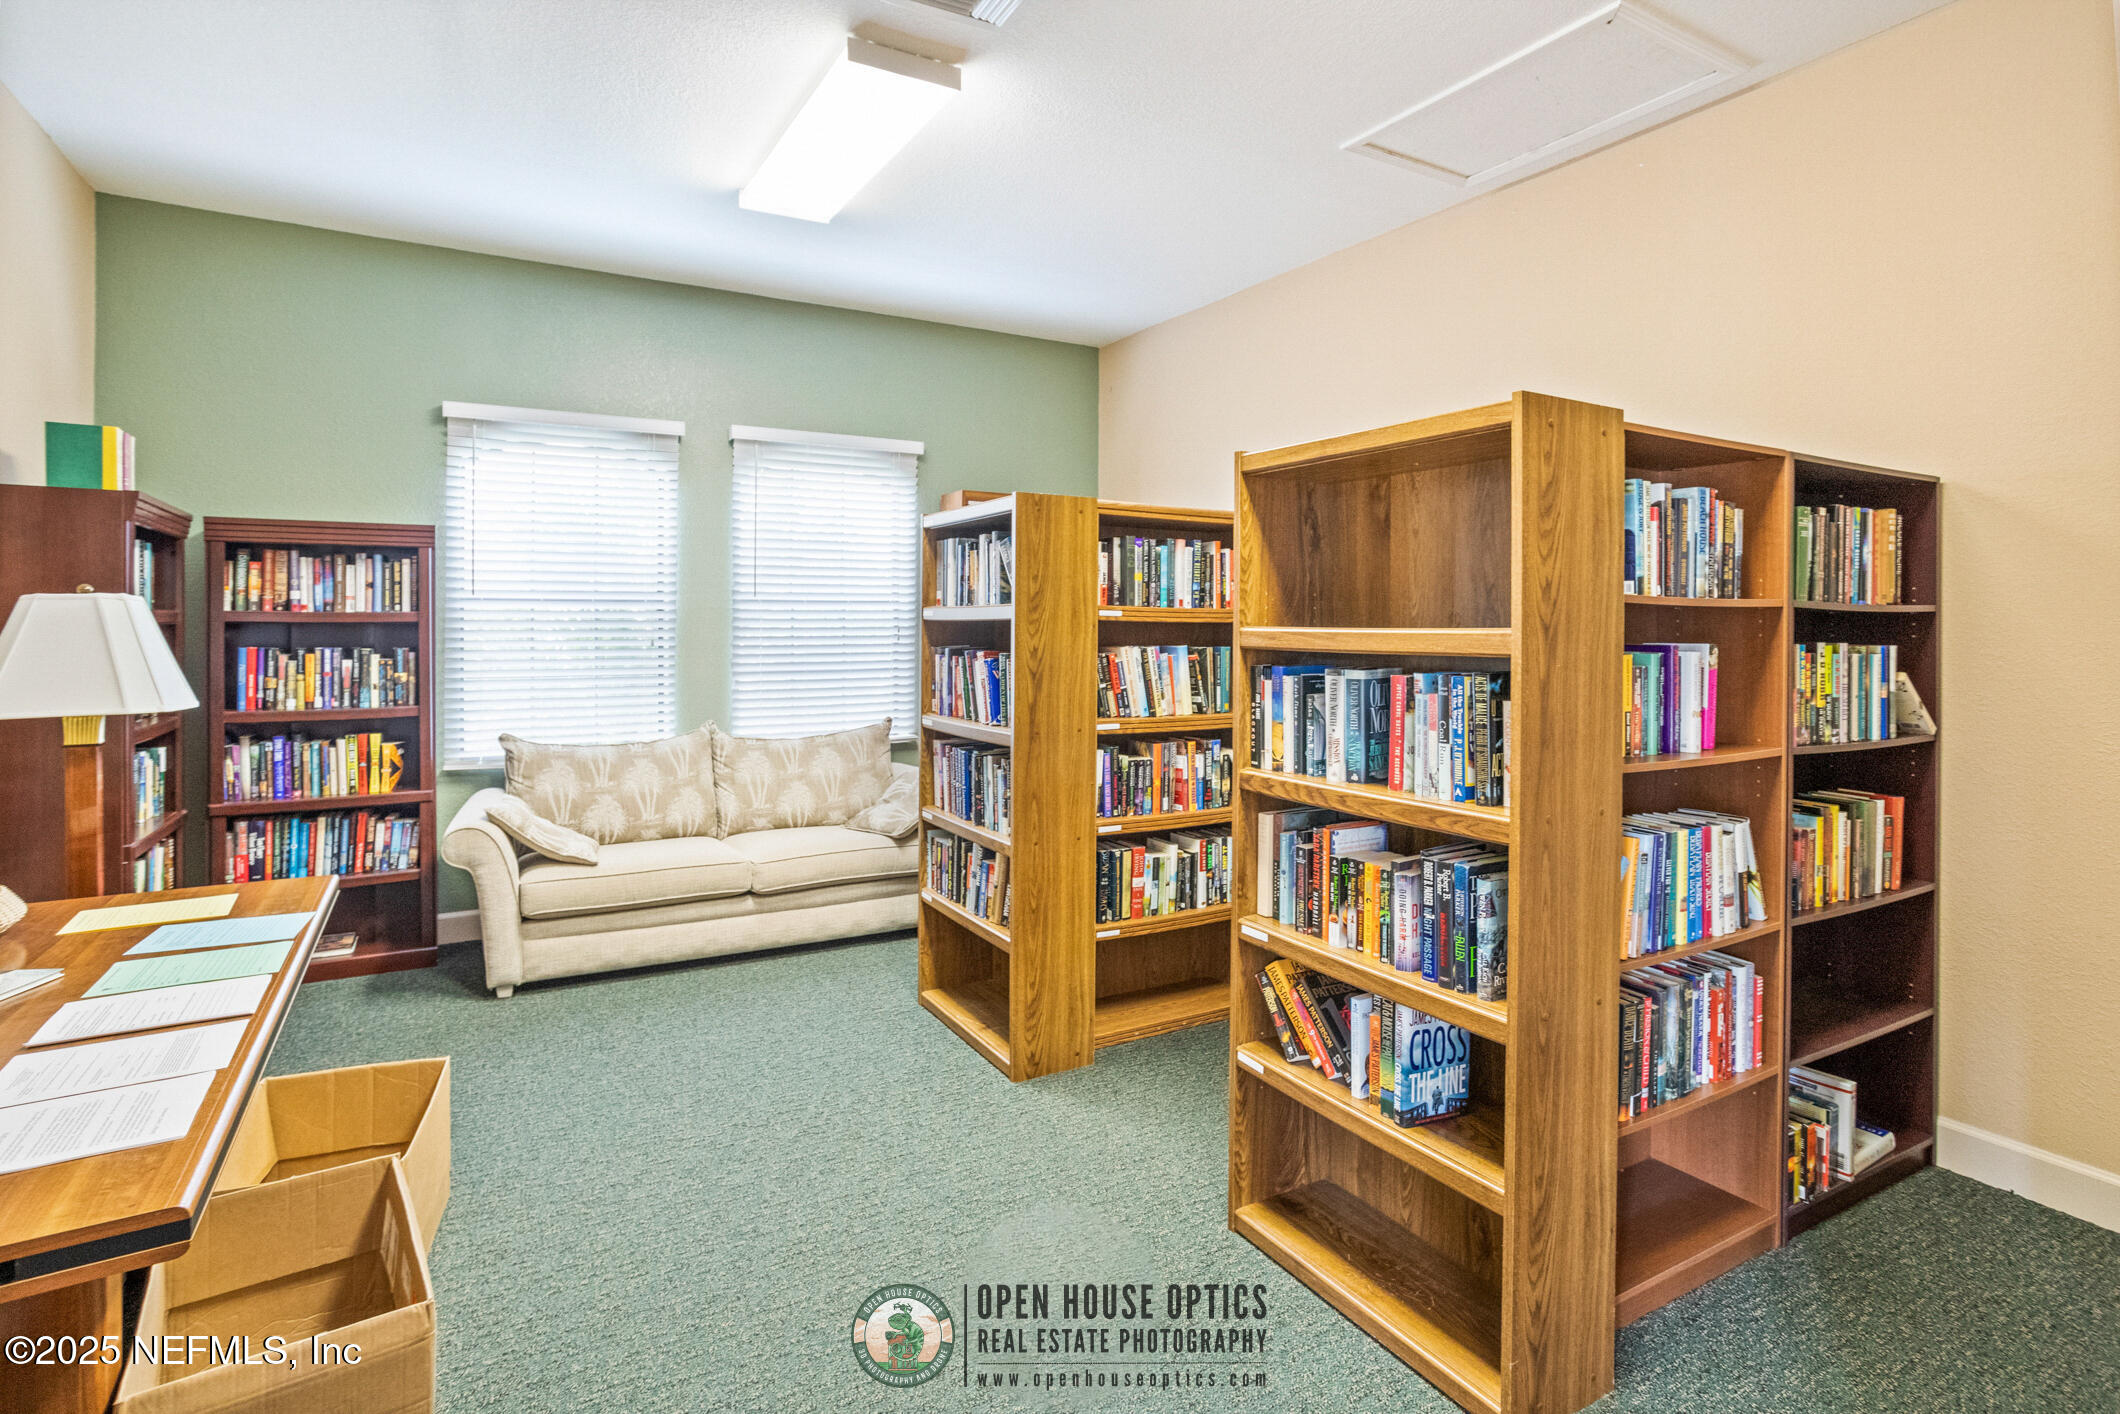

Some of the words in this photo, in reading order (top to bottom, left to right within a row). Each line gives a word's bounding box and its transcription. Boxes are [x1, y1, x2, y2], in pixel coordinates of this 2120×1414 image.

[1330, 678, 1339, 702] OLIVER
[1350, 681, 1360, 706] OLIVER
[1475, 676, 1488, 691] ACTS
[1475, 693, 1488, 701] OF
[1330, 704, 1339, 726] NORTH
[1350, 706, 1360, 730] NORTH
[1475, 702, 1488, 725] MALICE
[1439, 720, 1447, 743] Coal
[1476, 728, 1488, 745] PERRI
[1423, 860, 1434, 879] ROBERT
[1442, 869, 1451, 892] Robert
[1398, 889, 1408, 914] DOING
[1423, 886, 1434, 906] PARKER
[1442, 892, 1451, 901] B.
[1398, 917, 1408, 941] HARM
[1423, 907, 1435, 936] NIGHT
[1423, 937, 1433, 975] PASSAGE
[1455, 935, 1465, 962] FALLEN
[1267, 966, 1284, 991] JAMES
[1280, 992, 1307, 1039] PATTERSON
[1296, 983, 1312, 1007] JAMES
[1308, 1006, 1334, 1048] PATTERSON
[1396, 1010, 1404, 1029] JAMES
[1371, 1037, 1380, 1058] JAMES
[1396, 1029, 1404, 1059] PATTERSON
[1409, 1024, 1467, 1071] CROSS
[1371, 1058, 1380, 1093] PATTERSON
[1408, 1069, 1435, 1104] THE
[1438, 1063, 1467, 1098] LINE
